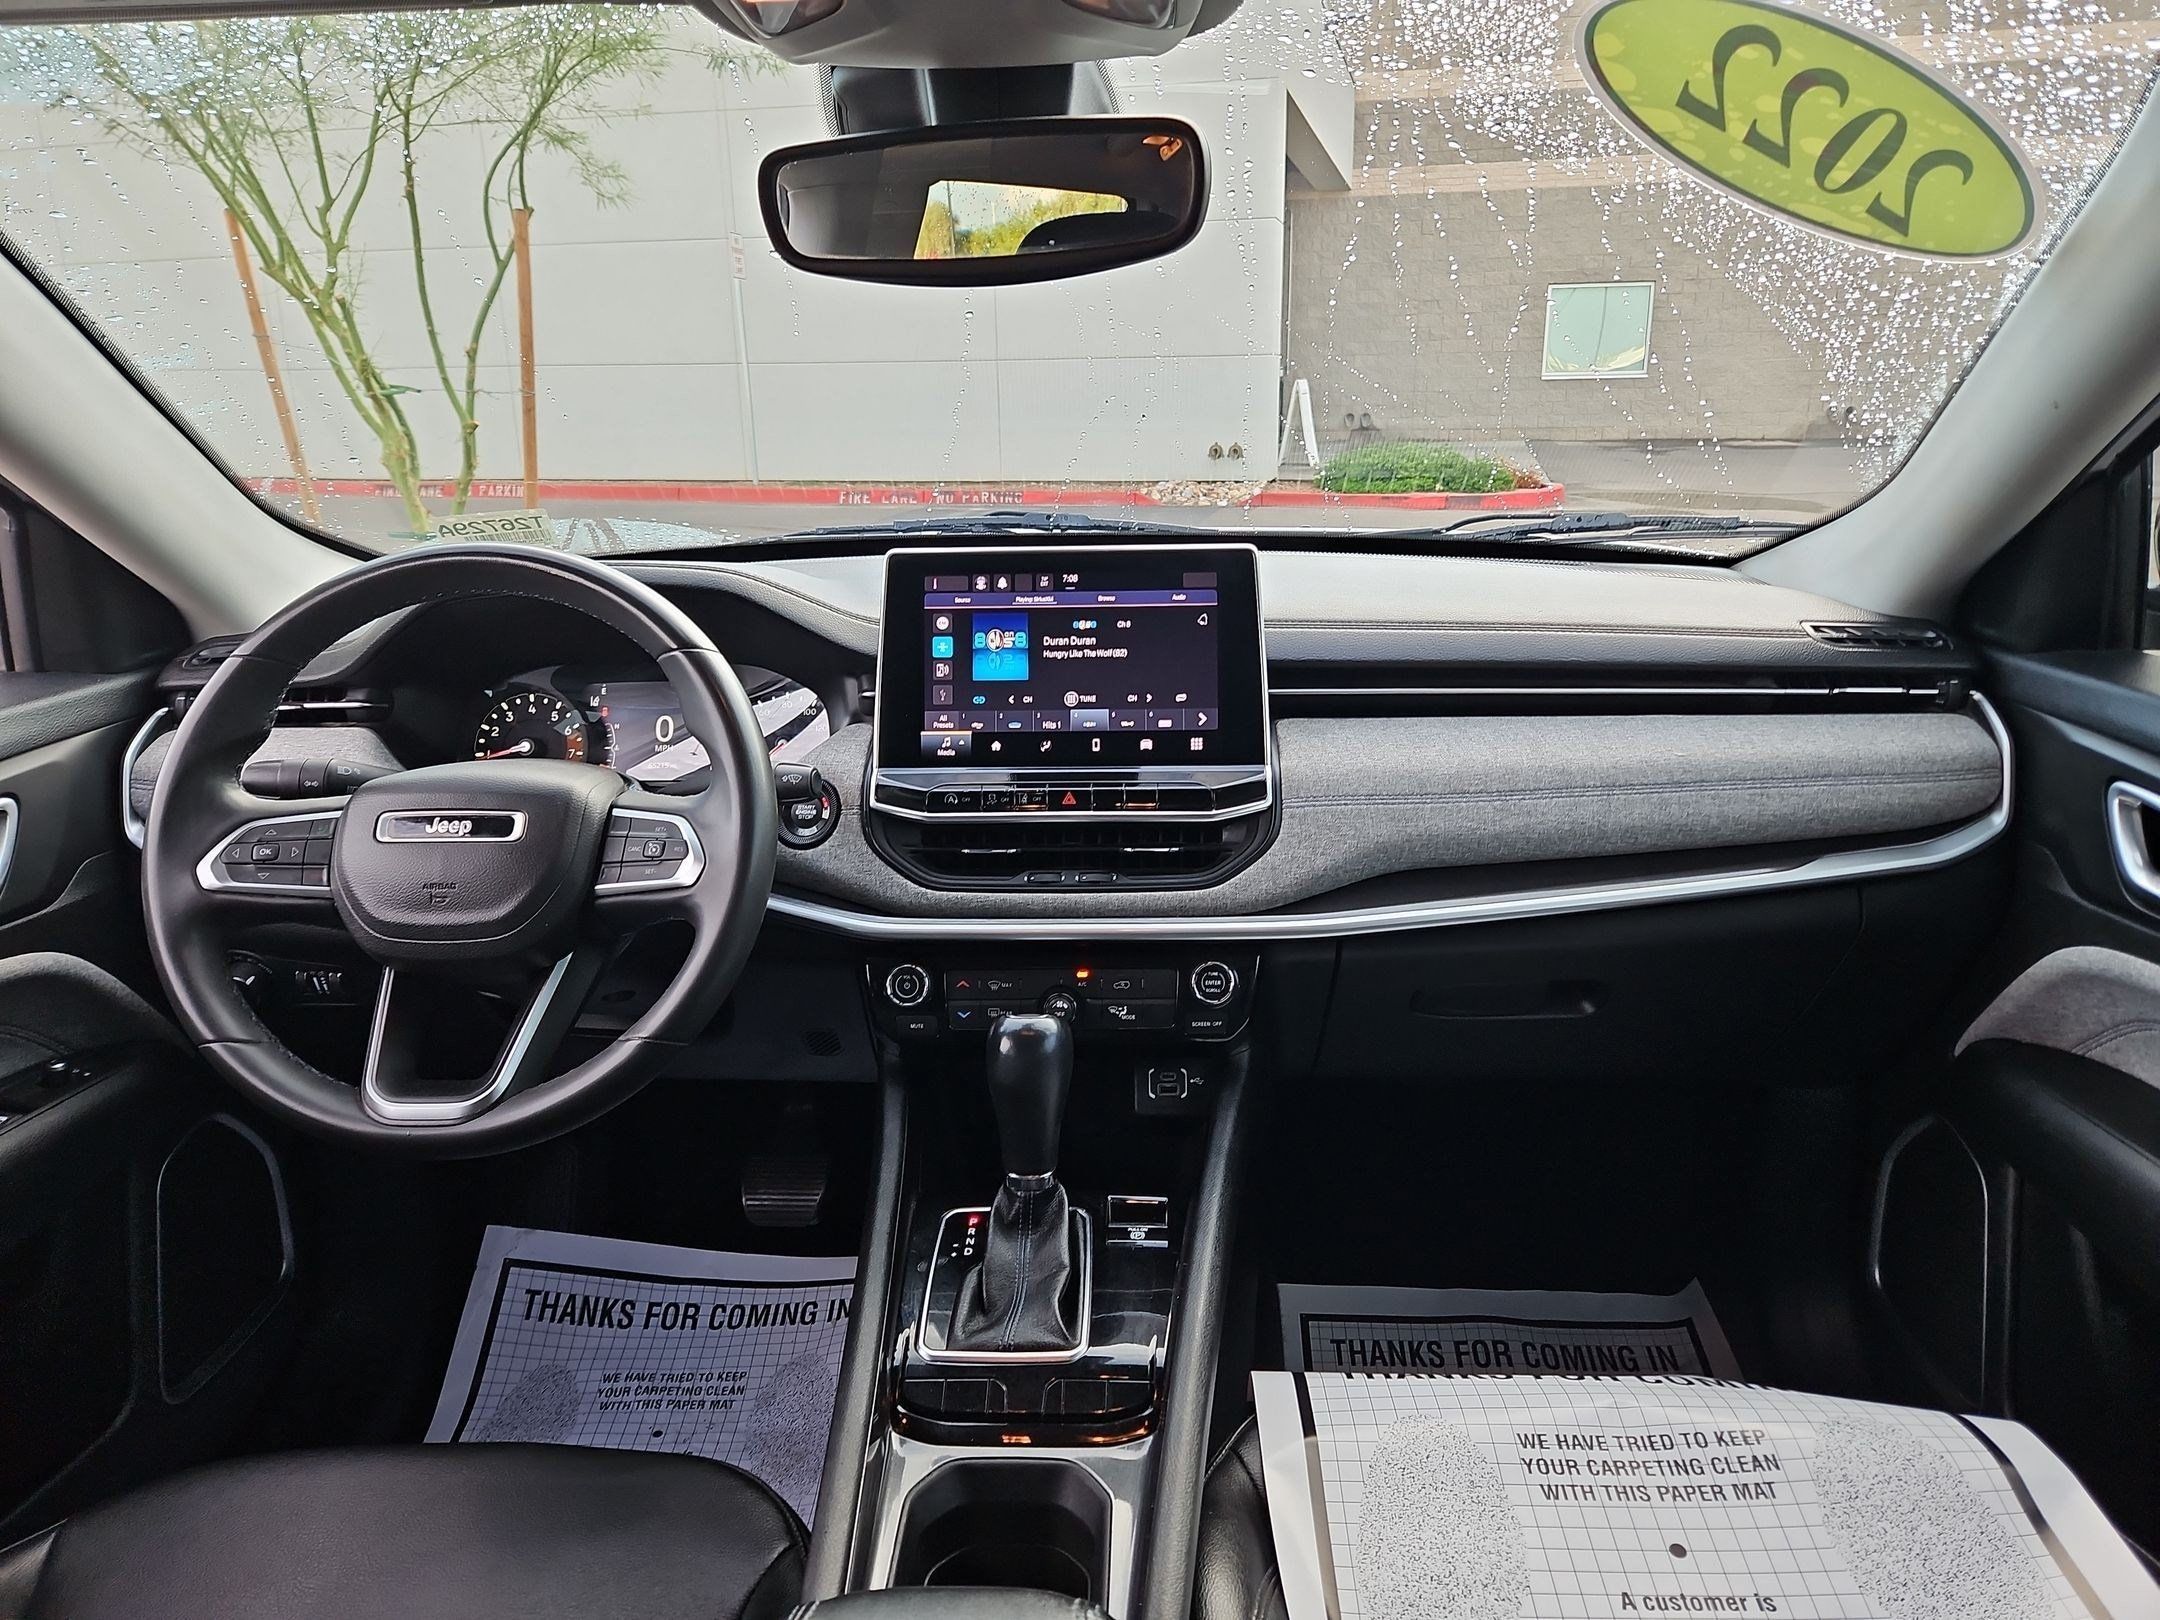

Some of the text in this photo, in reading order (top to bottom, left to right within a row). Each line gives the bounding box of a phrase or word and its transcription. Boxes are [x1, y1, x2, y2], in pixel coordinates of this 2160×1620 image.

[478, 484, 525, 498] PARKIN
[1043, 636, 1096, 646] Duran Duran
[1043, 650, 1069, 660] Hungry
[1069, 649, 1083, 658] Like
[1083, 649, 1096, 658] The
[1096, 649, 1113, 658] Wolf
[601, 687, 607, 696] E
[528, 704, 537, 714] 4
[803, 708, 817, 716] 100
[505, 711, 514, 722] 3
[551, 711, 559, 722] 5
[490, 726, 500, 737] 2
[564, 725, 572, 736] 6
[655, 715, 675, 743] 0
[568, 748, 576, 759] 7
[654, 744, 674, 752] MPH
[425, 817, 472, 837] Jeep
[259, 848, 272, 856] OK
[968, 1217, 978, 1226] P
[967, 1227, 976, 1235] R
[965, 1237, 975, 1245] N
[963, 1247, 973, 1256] D
[524, 1289, 637, 1330] THANKS
[643, 1301, 700, 1331] FOR
[707, 1301, 819, 1331] COMING
[1330, 1338, 1680, 1372] THANKS FOR COMING IN
[602, 1371, 748, 1383] WE HAVE TRIED TO KEEP
[598, 1385, 746, 1398] YOUR CARPETING CLEAN
[599, 1399, 736, 1411] WITH THIS PAPER MAT
[1516, 1429, 1766, 1452] WE HAVE TRIED TO KEEP
[1520, 1453, 1781, 1477] YOUR CARPETING CLEAN
[1538, 1481, 1778, 1502] WITH THIS PAPER MAT
[1621, 1592, 1777, 1612] A customer is
